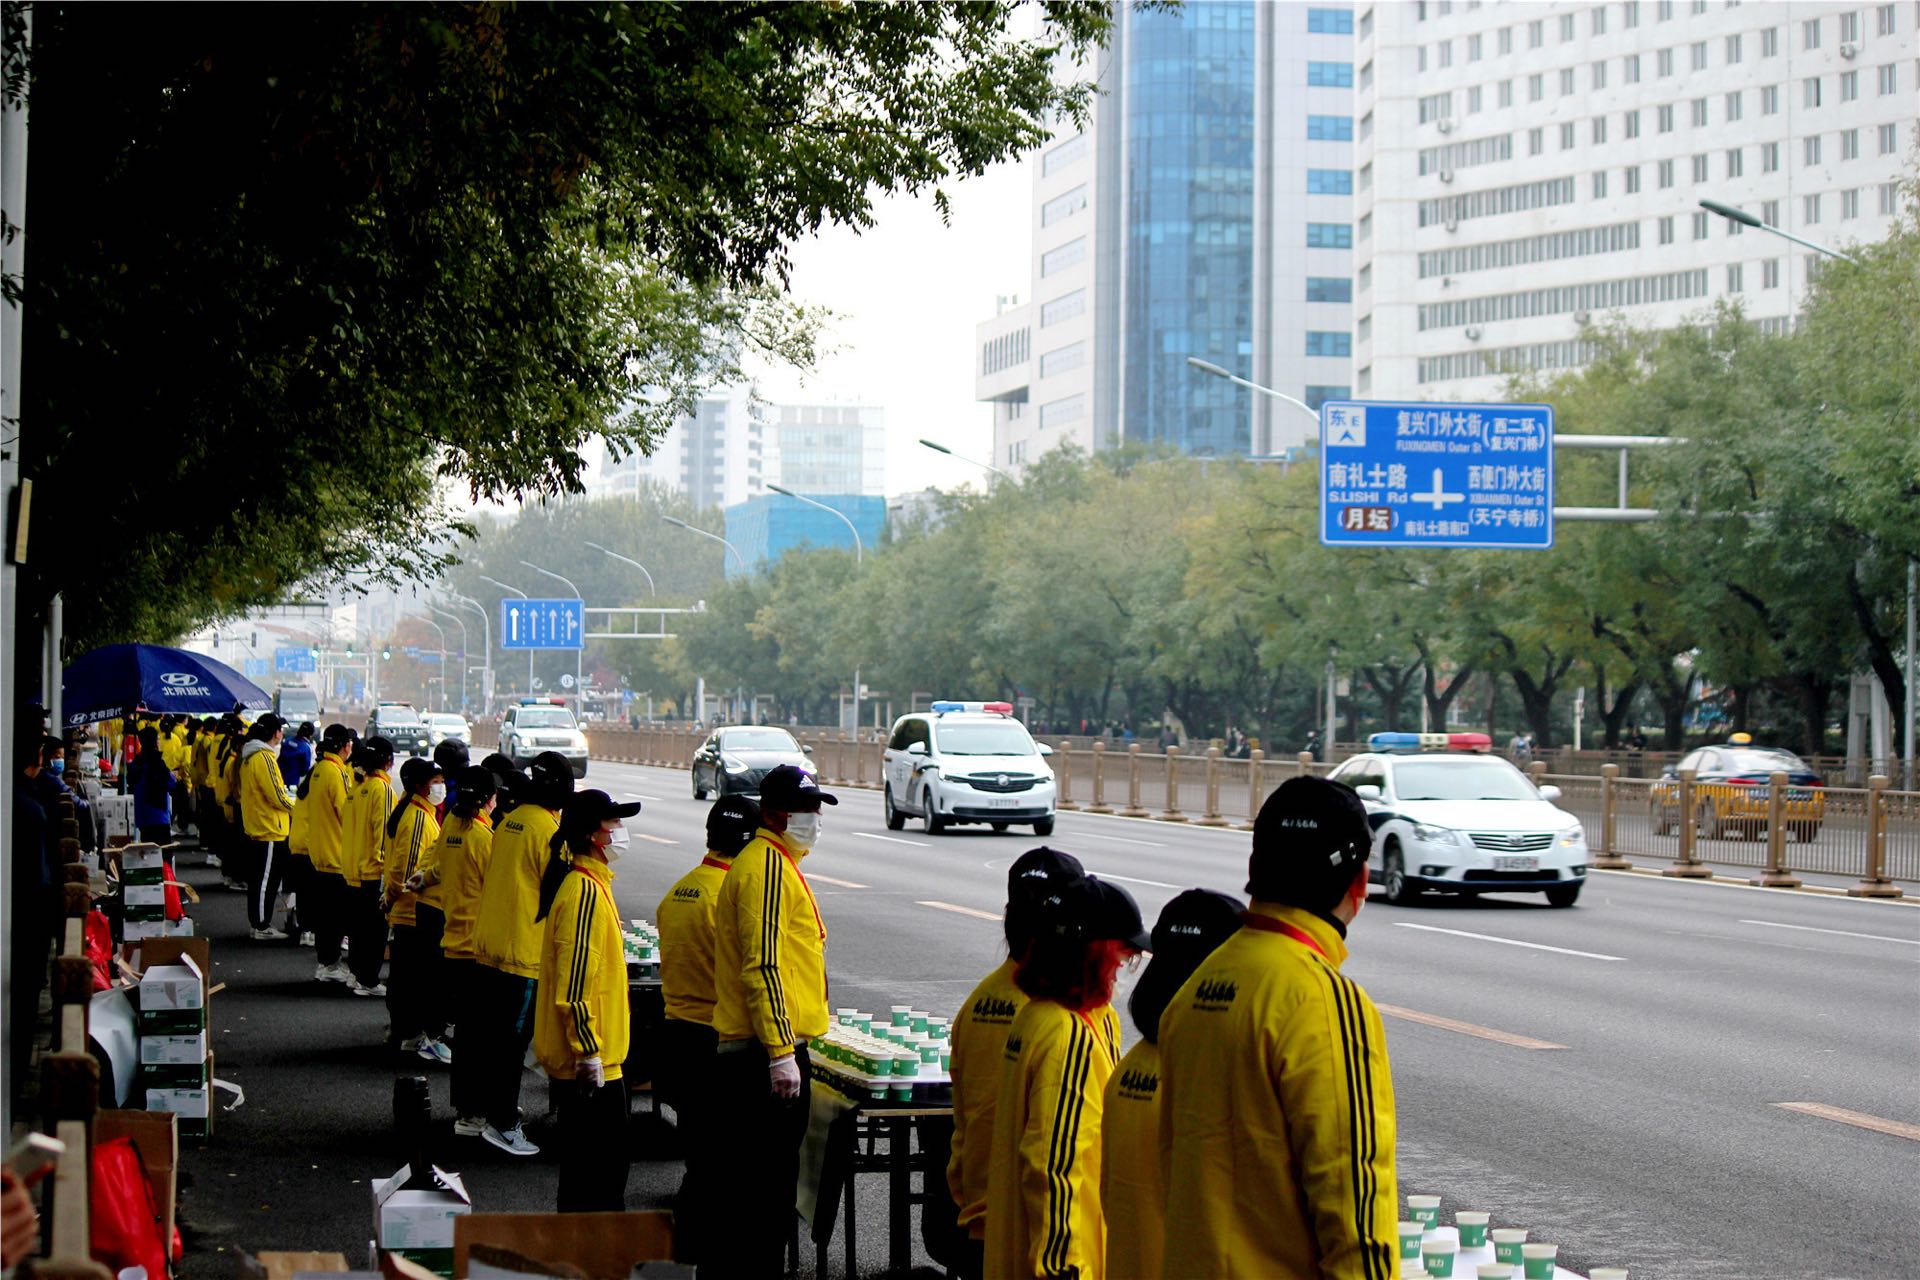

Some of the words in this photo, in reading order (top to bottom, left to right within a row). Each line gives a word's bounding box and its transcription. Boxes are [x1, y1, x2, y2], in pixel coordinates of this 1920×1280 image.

[1330, 409, 1346, 426] 东
[1352, 415, 1360, 426] E
[1396, 410, 1482, 437] 复兴门外大街
[1328, 462, 1408, 489] 南礼士路
[1468, 465, 1545, 491] 西便门外大街
[1387, 492, 1408, 504] Rd
[162, 687, 210, 696] 北京现代
